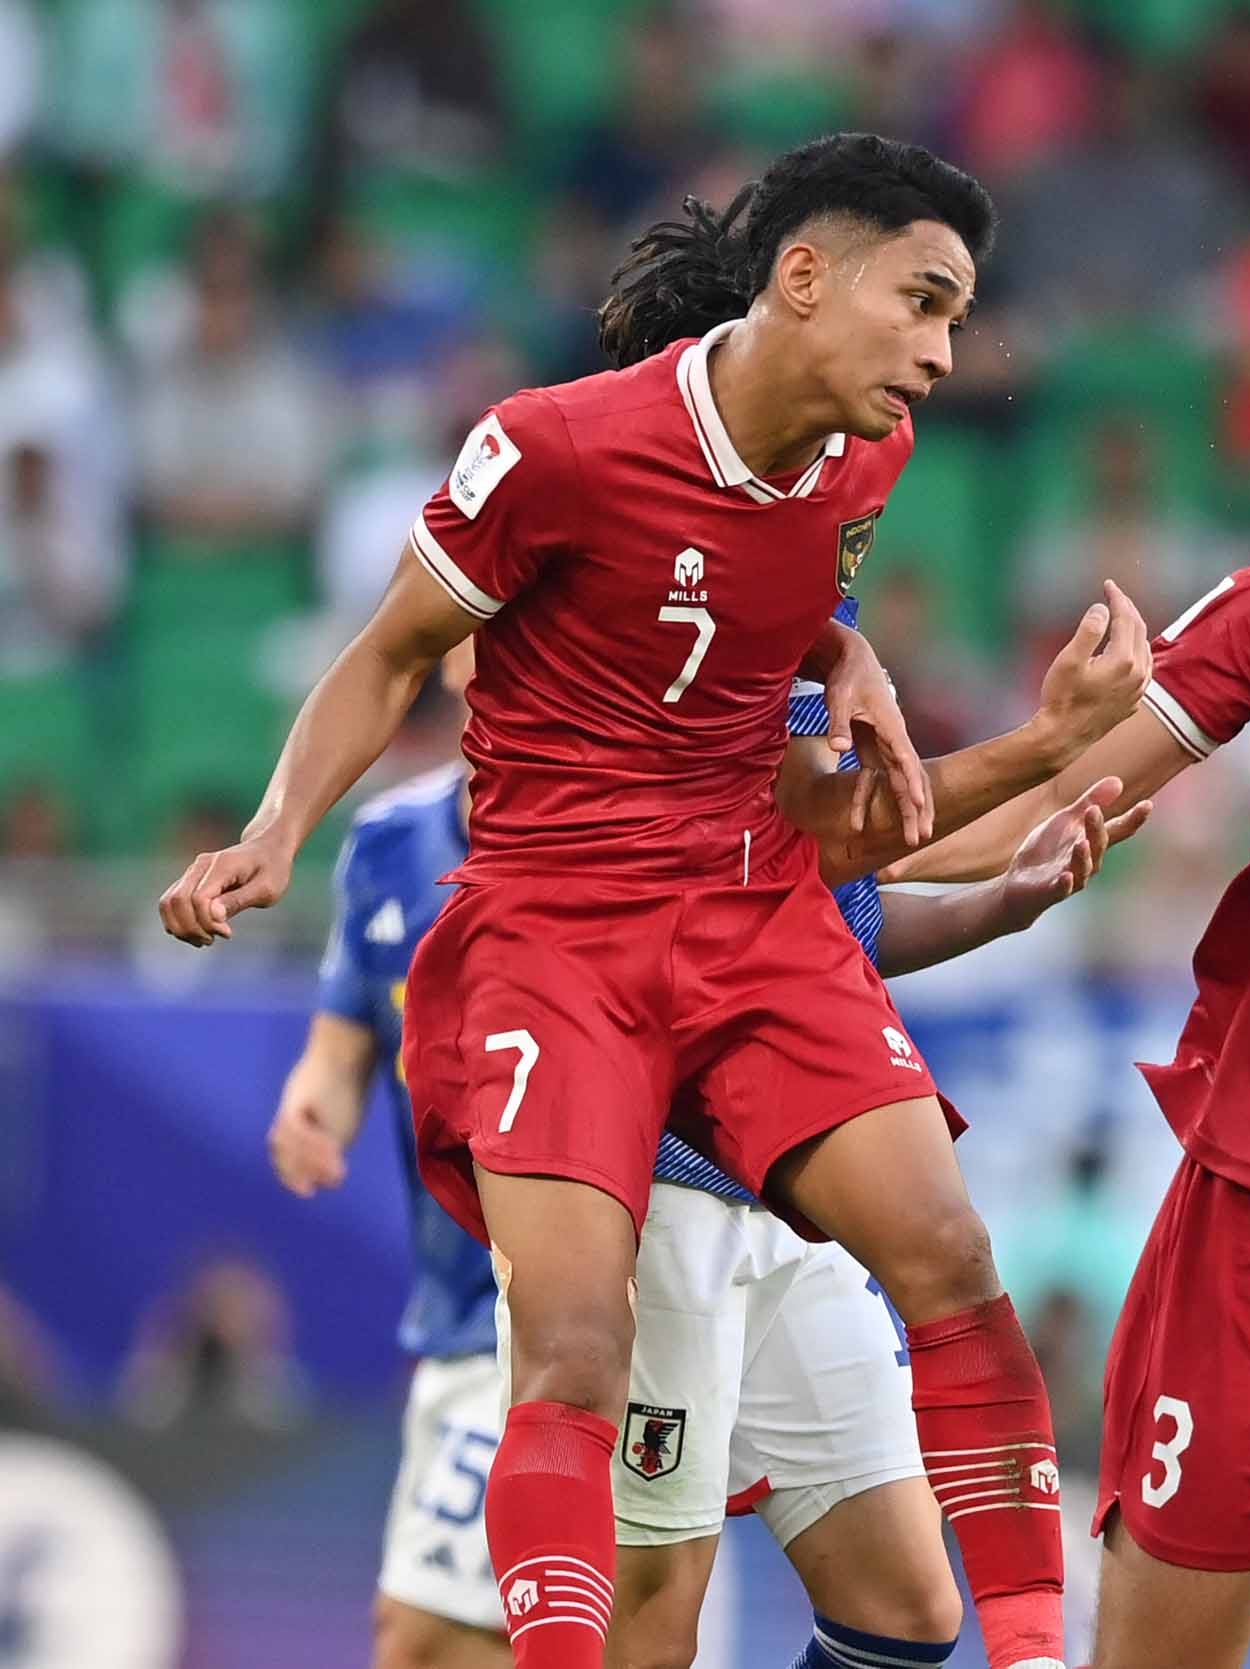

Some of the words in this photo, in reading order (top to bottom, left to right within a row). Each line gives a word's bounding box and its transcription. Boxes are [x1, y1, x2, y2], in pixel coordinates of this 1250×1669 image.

[668, 590, 708, 602] MILLS
[658, 606, 716, 702] 7
[484, 1029, 540, 1133] 7
[890, 1056, 923, 1073] MILLS
[640, 1405, 674, 1418] JAPAN
[1142, 1395, 1194, 1508] 3
